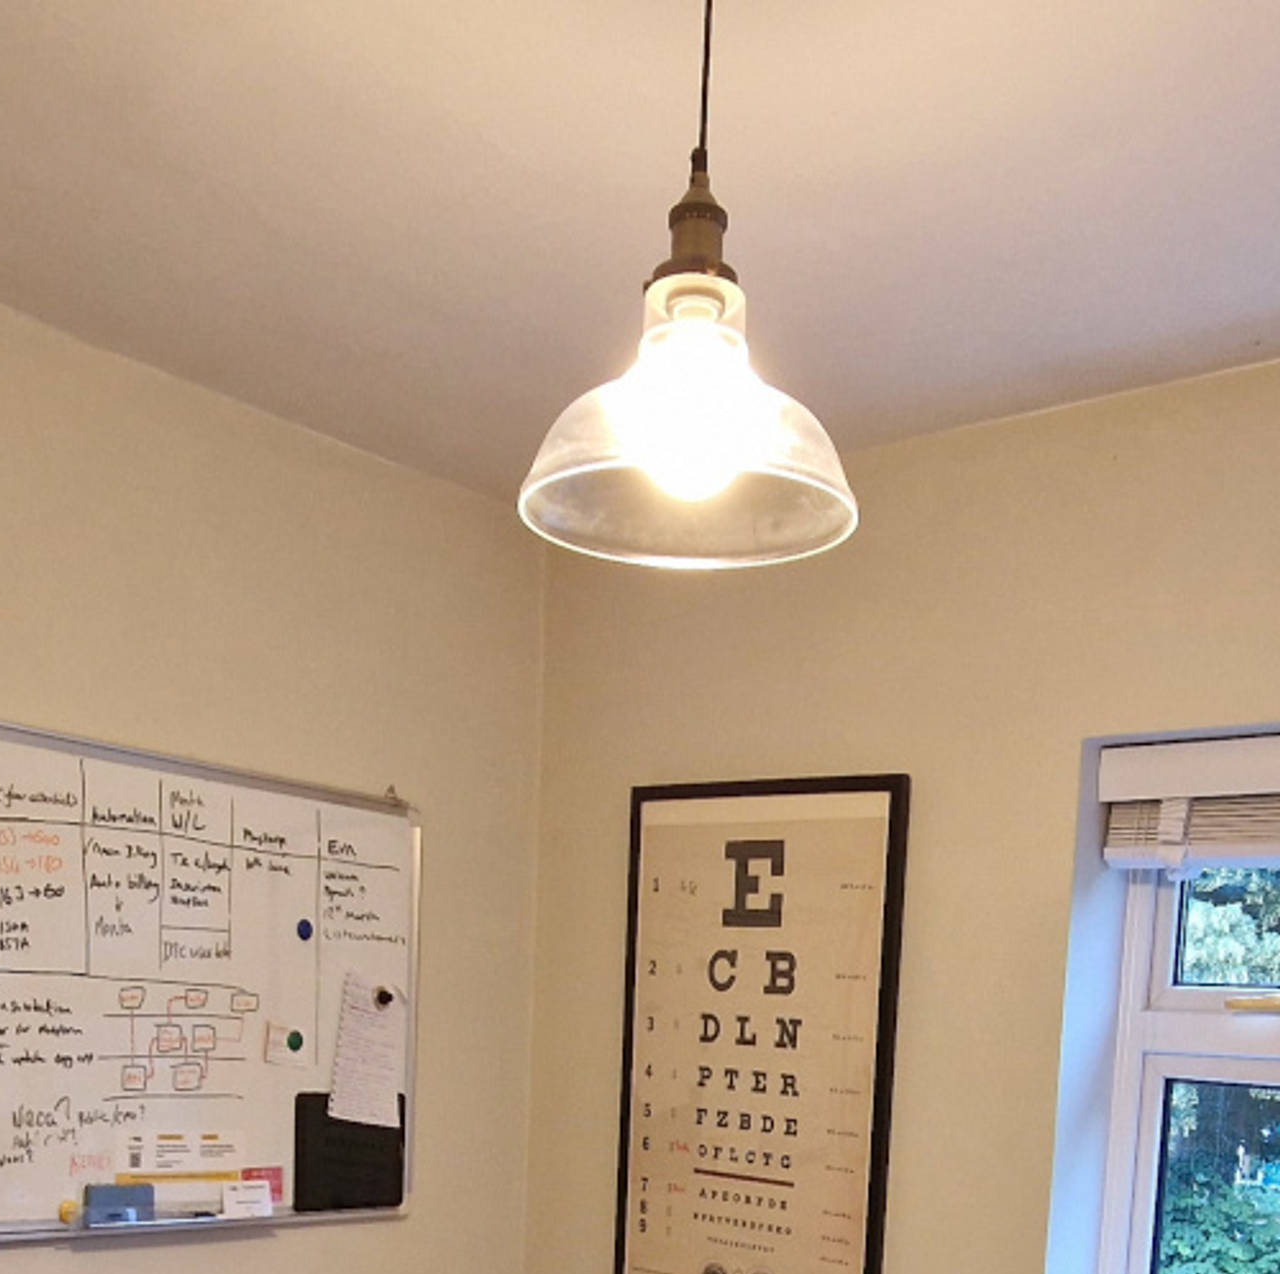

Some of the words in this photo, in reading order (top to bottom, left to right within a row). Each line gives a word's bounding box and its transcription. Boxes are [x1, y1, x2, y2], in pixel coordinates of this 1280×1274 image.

[652, 877, 660, 893] 1
[722, 839, 785, 927] E
[647, 959, 658, 976] 2
[647, 1016, 655, 1032] 3
[644, 1063, 653, 1080] 4
[643, 1103, 652, 1118] 5
[642, 1136, 651, 1151] 6
[640, 1176, 650, 1192] 7
